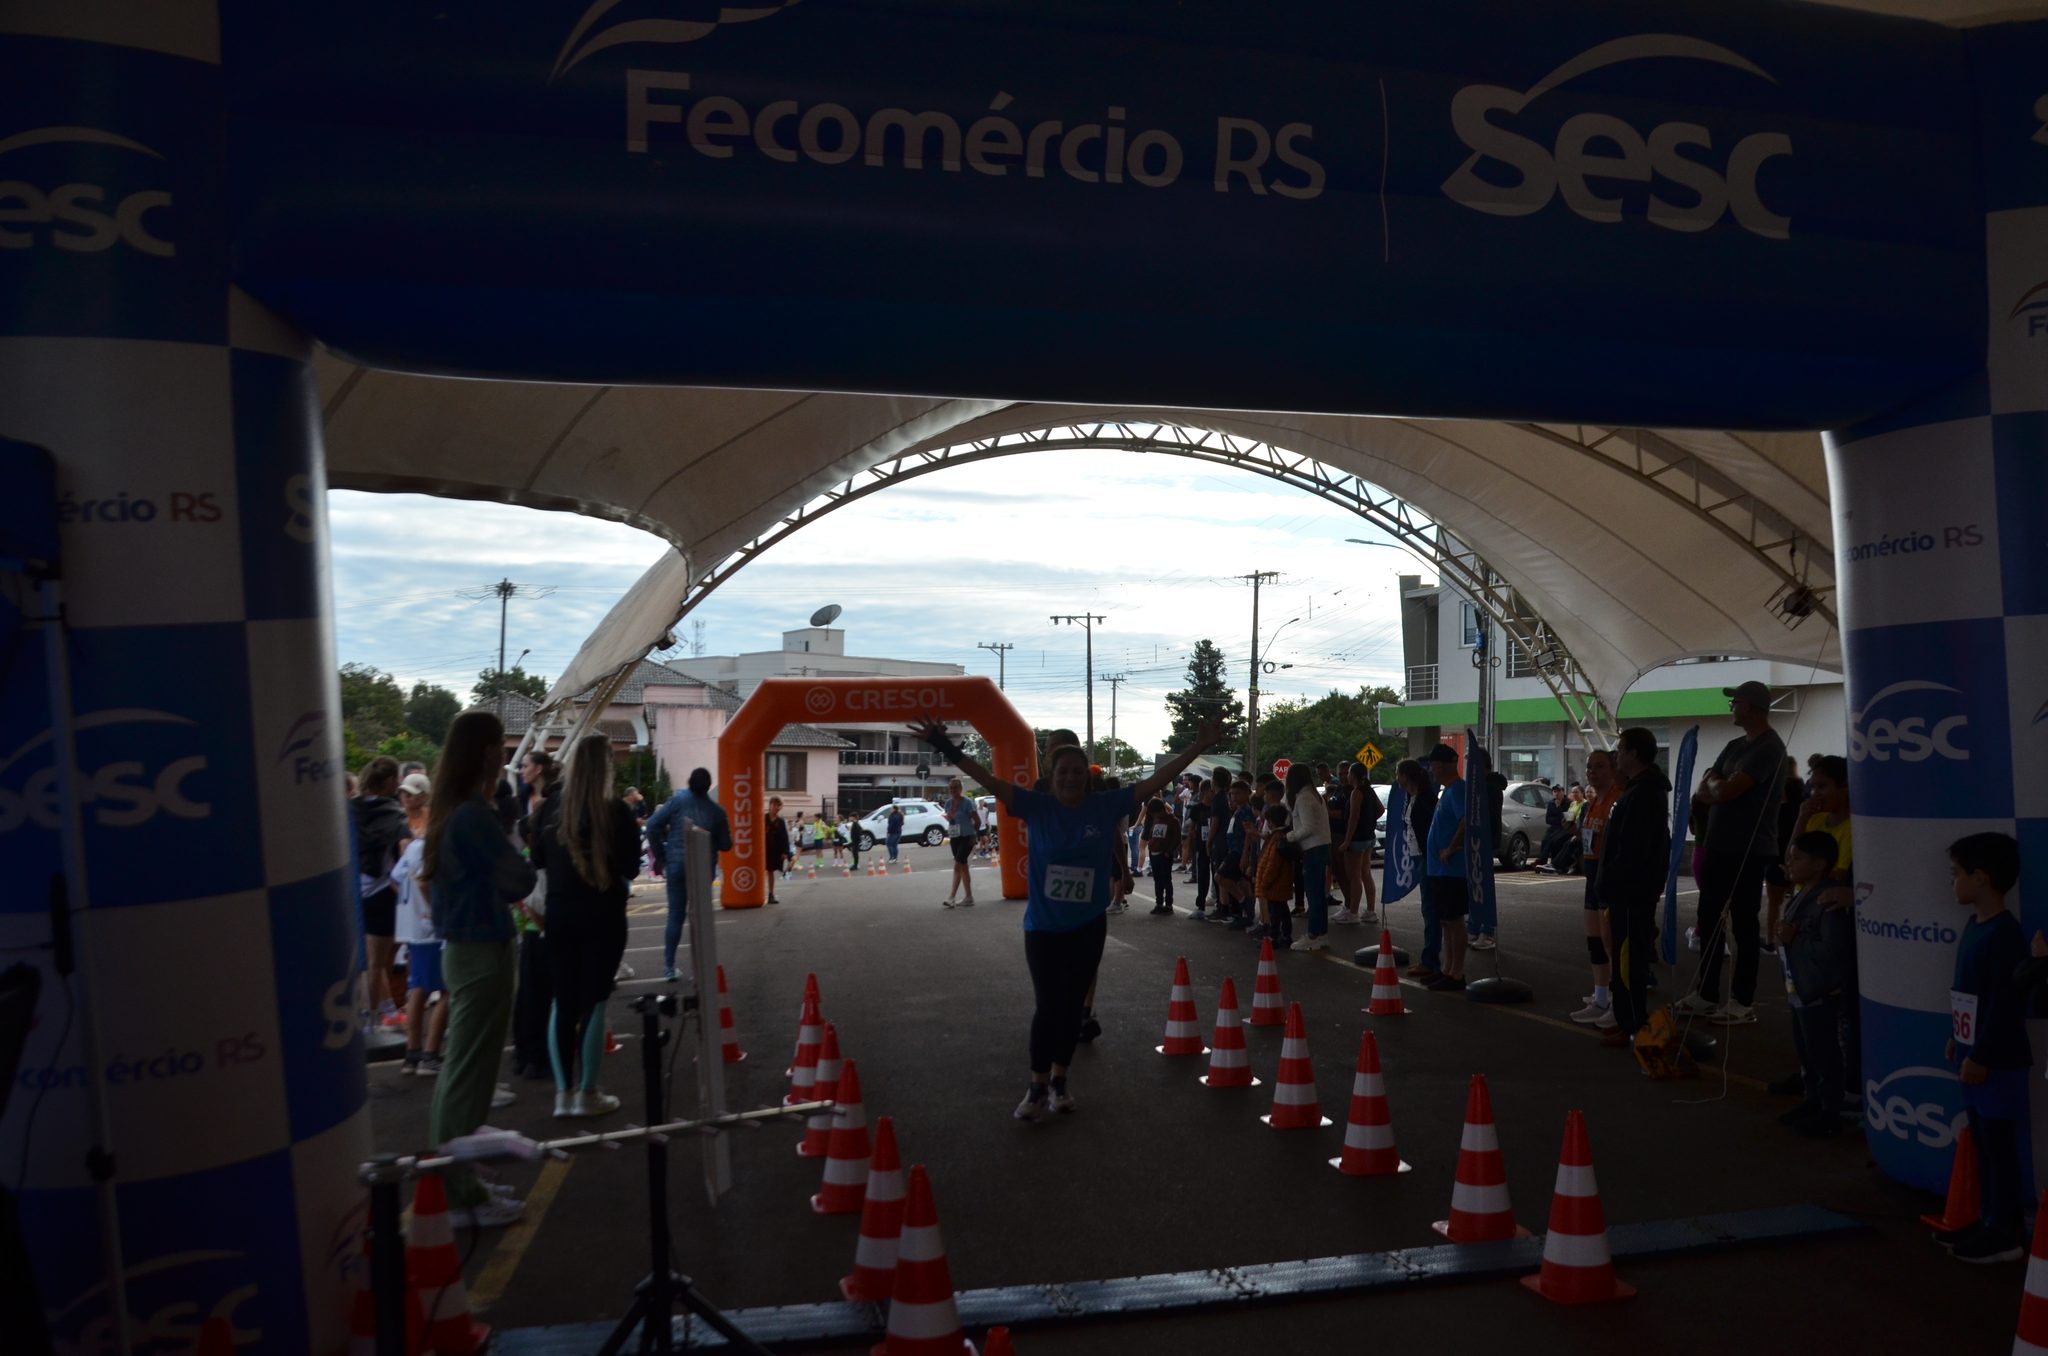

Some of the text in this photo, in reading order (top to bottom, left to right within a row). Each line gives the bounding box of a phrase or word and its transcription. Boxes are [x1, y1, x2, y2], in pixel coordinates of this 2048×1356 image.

[626, 68, 1327, 199] Fecomércio RS
[1441, 83, 1793, 240] Sesc
[58, 491, 222, 524] ércio RS
[1944, 523, 1983, 549] RS
[845, 687, 954, 711] CRESOL
[1274, 765, 1289, 774] PAR
[733, 766, 751, 860] CRESOL
[1050, 878, 1087, 900] 278
[216, 1032, 266, 1068] RS
